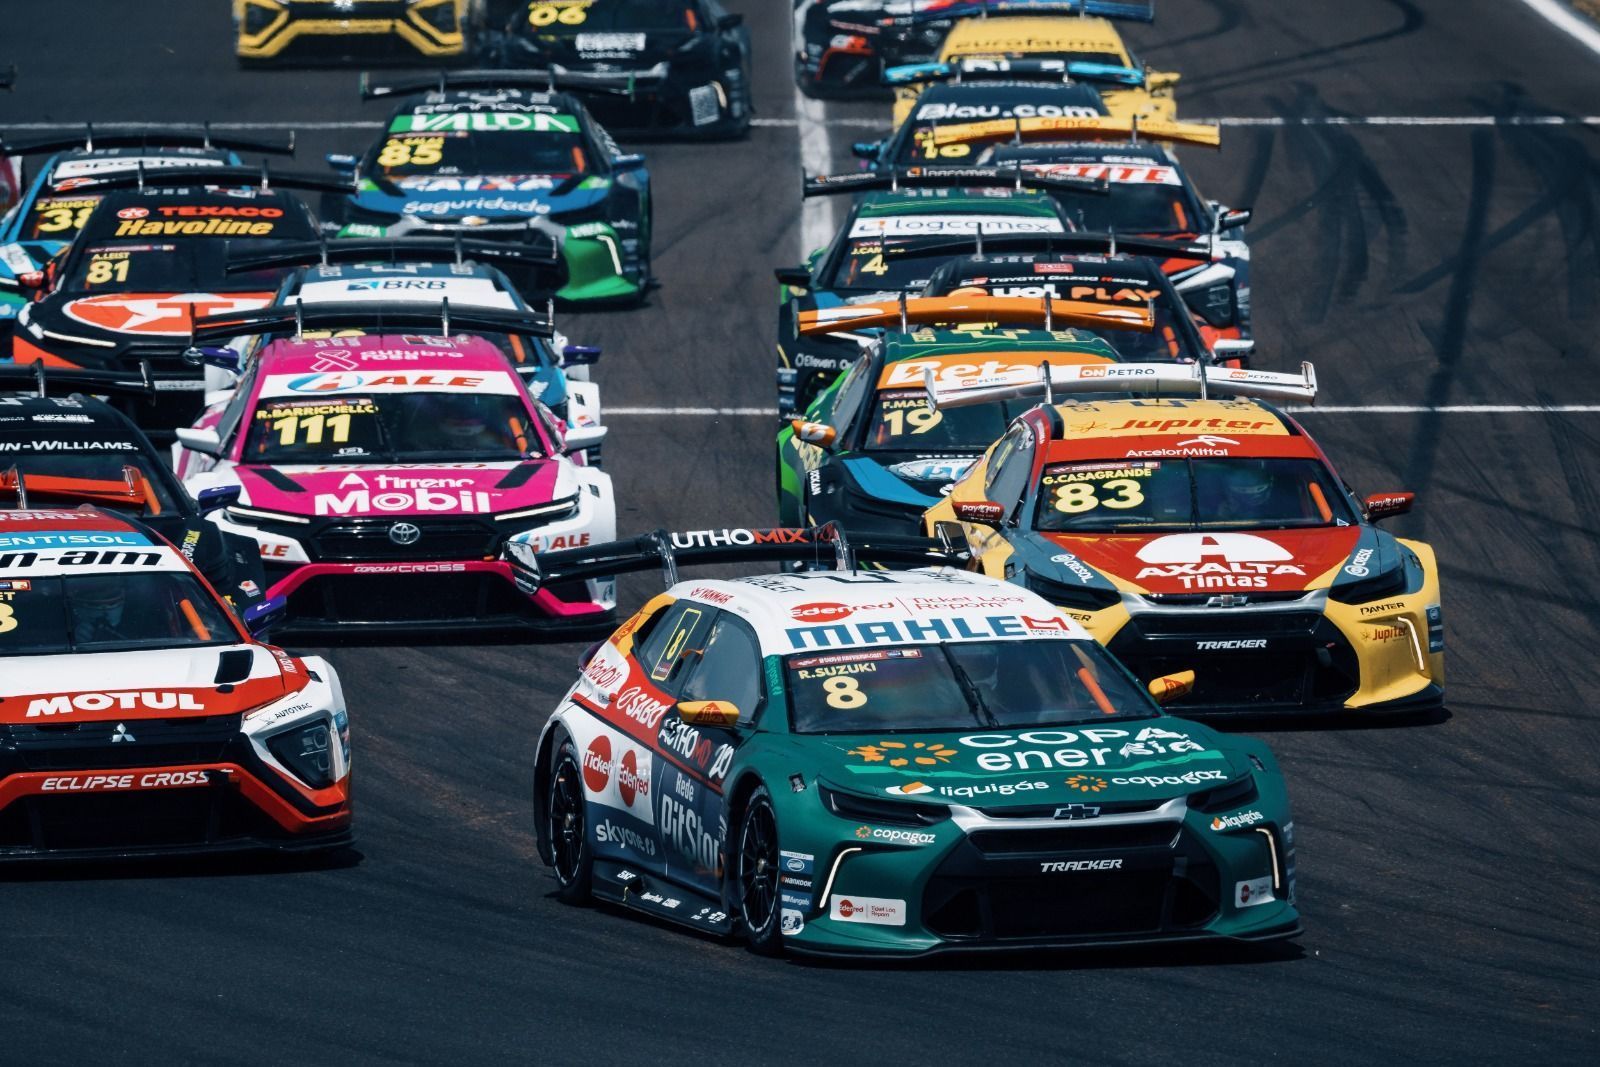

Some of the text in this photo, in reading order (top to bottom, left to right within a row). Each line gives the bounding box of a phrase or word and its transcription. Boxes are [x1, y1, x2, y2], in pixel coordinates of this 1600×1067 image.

[528, 6, 587, 26] 06
[916, 102, 1098, 120] Blau.com
[377, 143, 443, 166] 85
[157, 206, 284, 218] TEXACO
[401, 197, 551, 214] Seguridade
[114, 219, 275, 237] Havoline
[893, 216, 1052, 233] logcomex
[86, 259, 130, 284] 81
[860, 253, 889, 276] 4
[382, 280, 447, 290] BRB
[1071, 286, 1162, 302] PLAY
[365, 375, 487, 388] ALE
[1081, 368, 1156, 378] ON PETRO
[1230, 371, 1248, 379] ON
[272, 413, 352, 446] 111
[883, 408, 944, 436] 19
[1110, 417, 1274, 432] Jupiter
[1126, 448, 1229, 457] ArcelorMittal
[1042, 468, 1152, 485] G.CASAGRANDE
[314, 488, 491, 515] Mobil
[1054, 478, 1145, 514] 83
[550, 533, 591, 550] ALE
[672, 527, 810, 550] UTHOMIX
[399, 564, 466, 573] CROSS
[1135, 562, 1307, 579] AXALTA
[1176, 574, 1269, 589] Tintas
[1360, 602, 1406, 616] PANTER
[784, 614, 1030, 650] MAHLE
[1372, 625, 1408, 644] Jupiter
[1196, 639, 1268, 650] TRACKER
[797, 662, 877, 680] R.SUZUKI
[822, 675, 868, 710] 8
[26, 691, 205, 718] MOTUL
[274, 702, 313, 719] AUTOTRAC
[41, 770, 211, 791] ECLIPSE CROSS
[675, 773, 695, 801] Rede
[1111, 768, 1229, 788] copagaz
[940, 779, 1049, 797] liquigás
[1222, 810, 1264, 828] liquigás
[873, 828, 936, 844] copagaz
[1040, 858, 1123, 873] TRACKER
